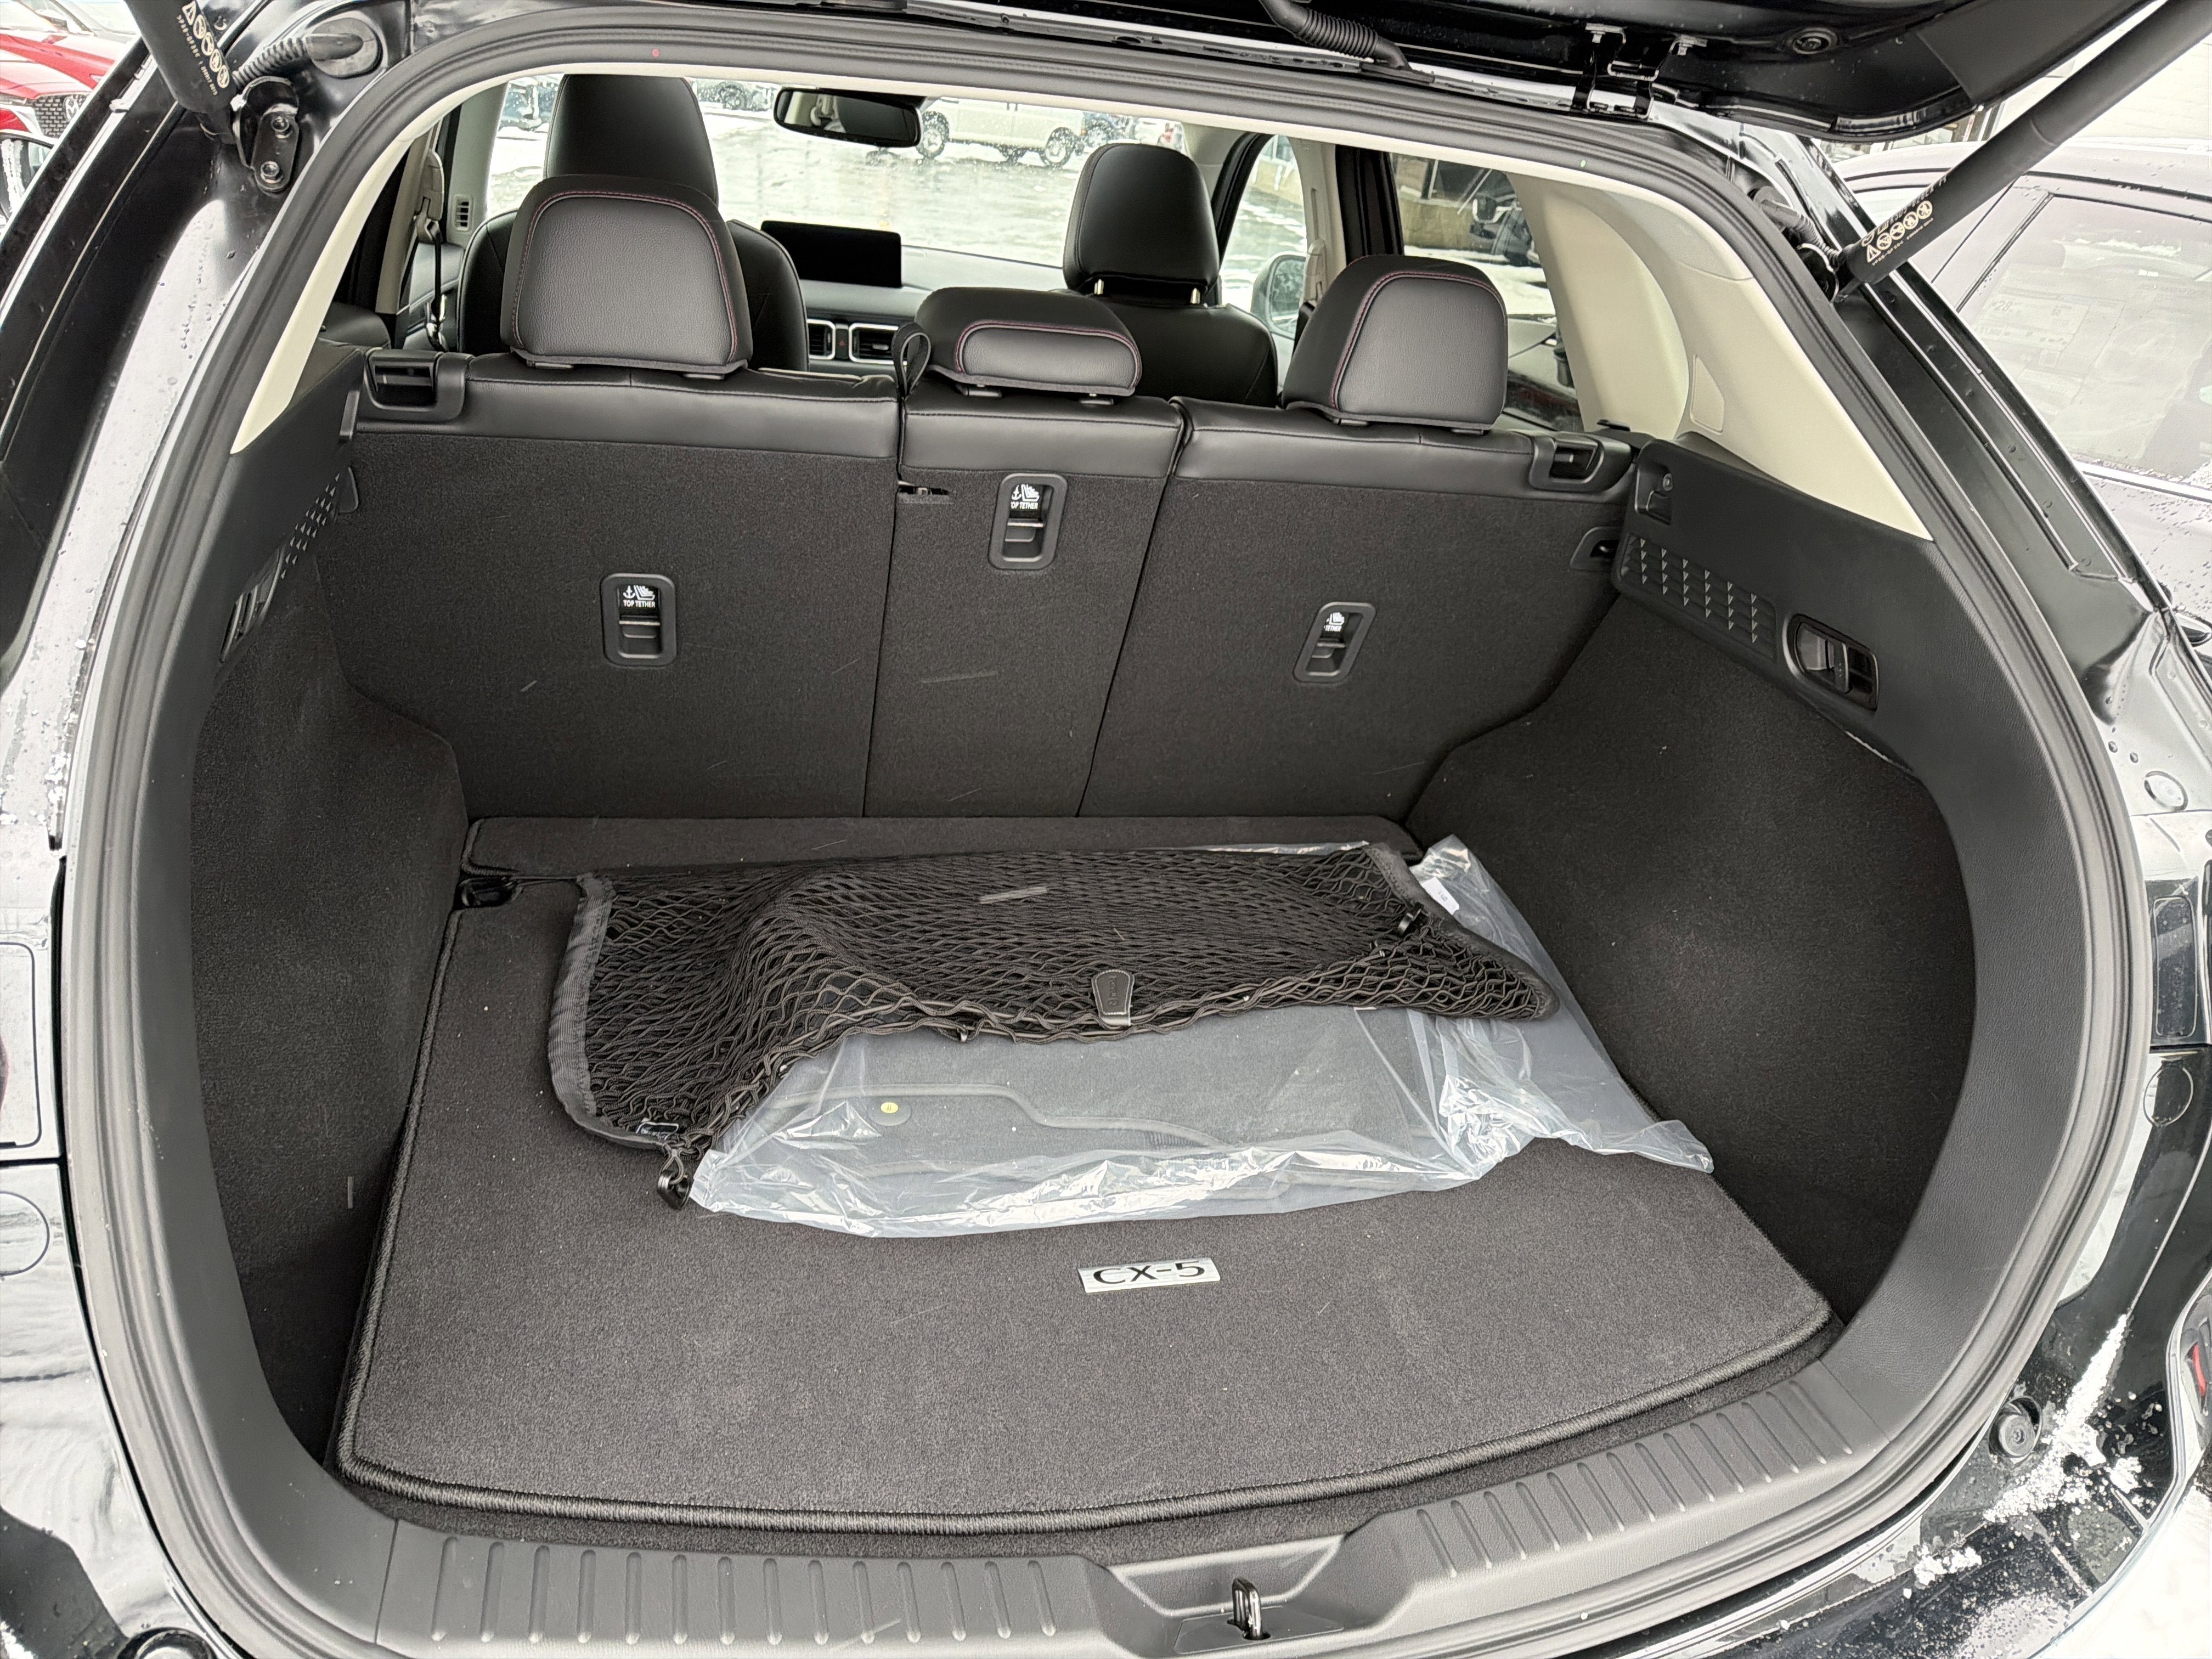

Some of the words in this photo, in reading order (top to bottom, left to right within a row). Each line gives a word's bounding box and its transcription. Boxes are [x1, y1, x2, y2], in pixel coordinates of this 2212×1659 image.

[623, 599, 635, 607] TOP
[635, 600, 656, 608] TETHER
[1093, 1260, 1205, 1284] CX-5
